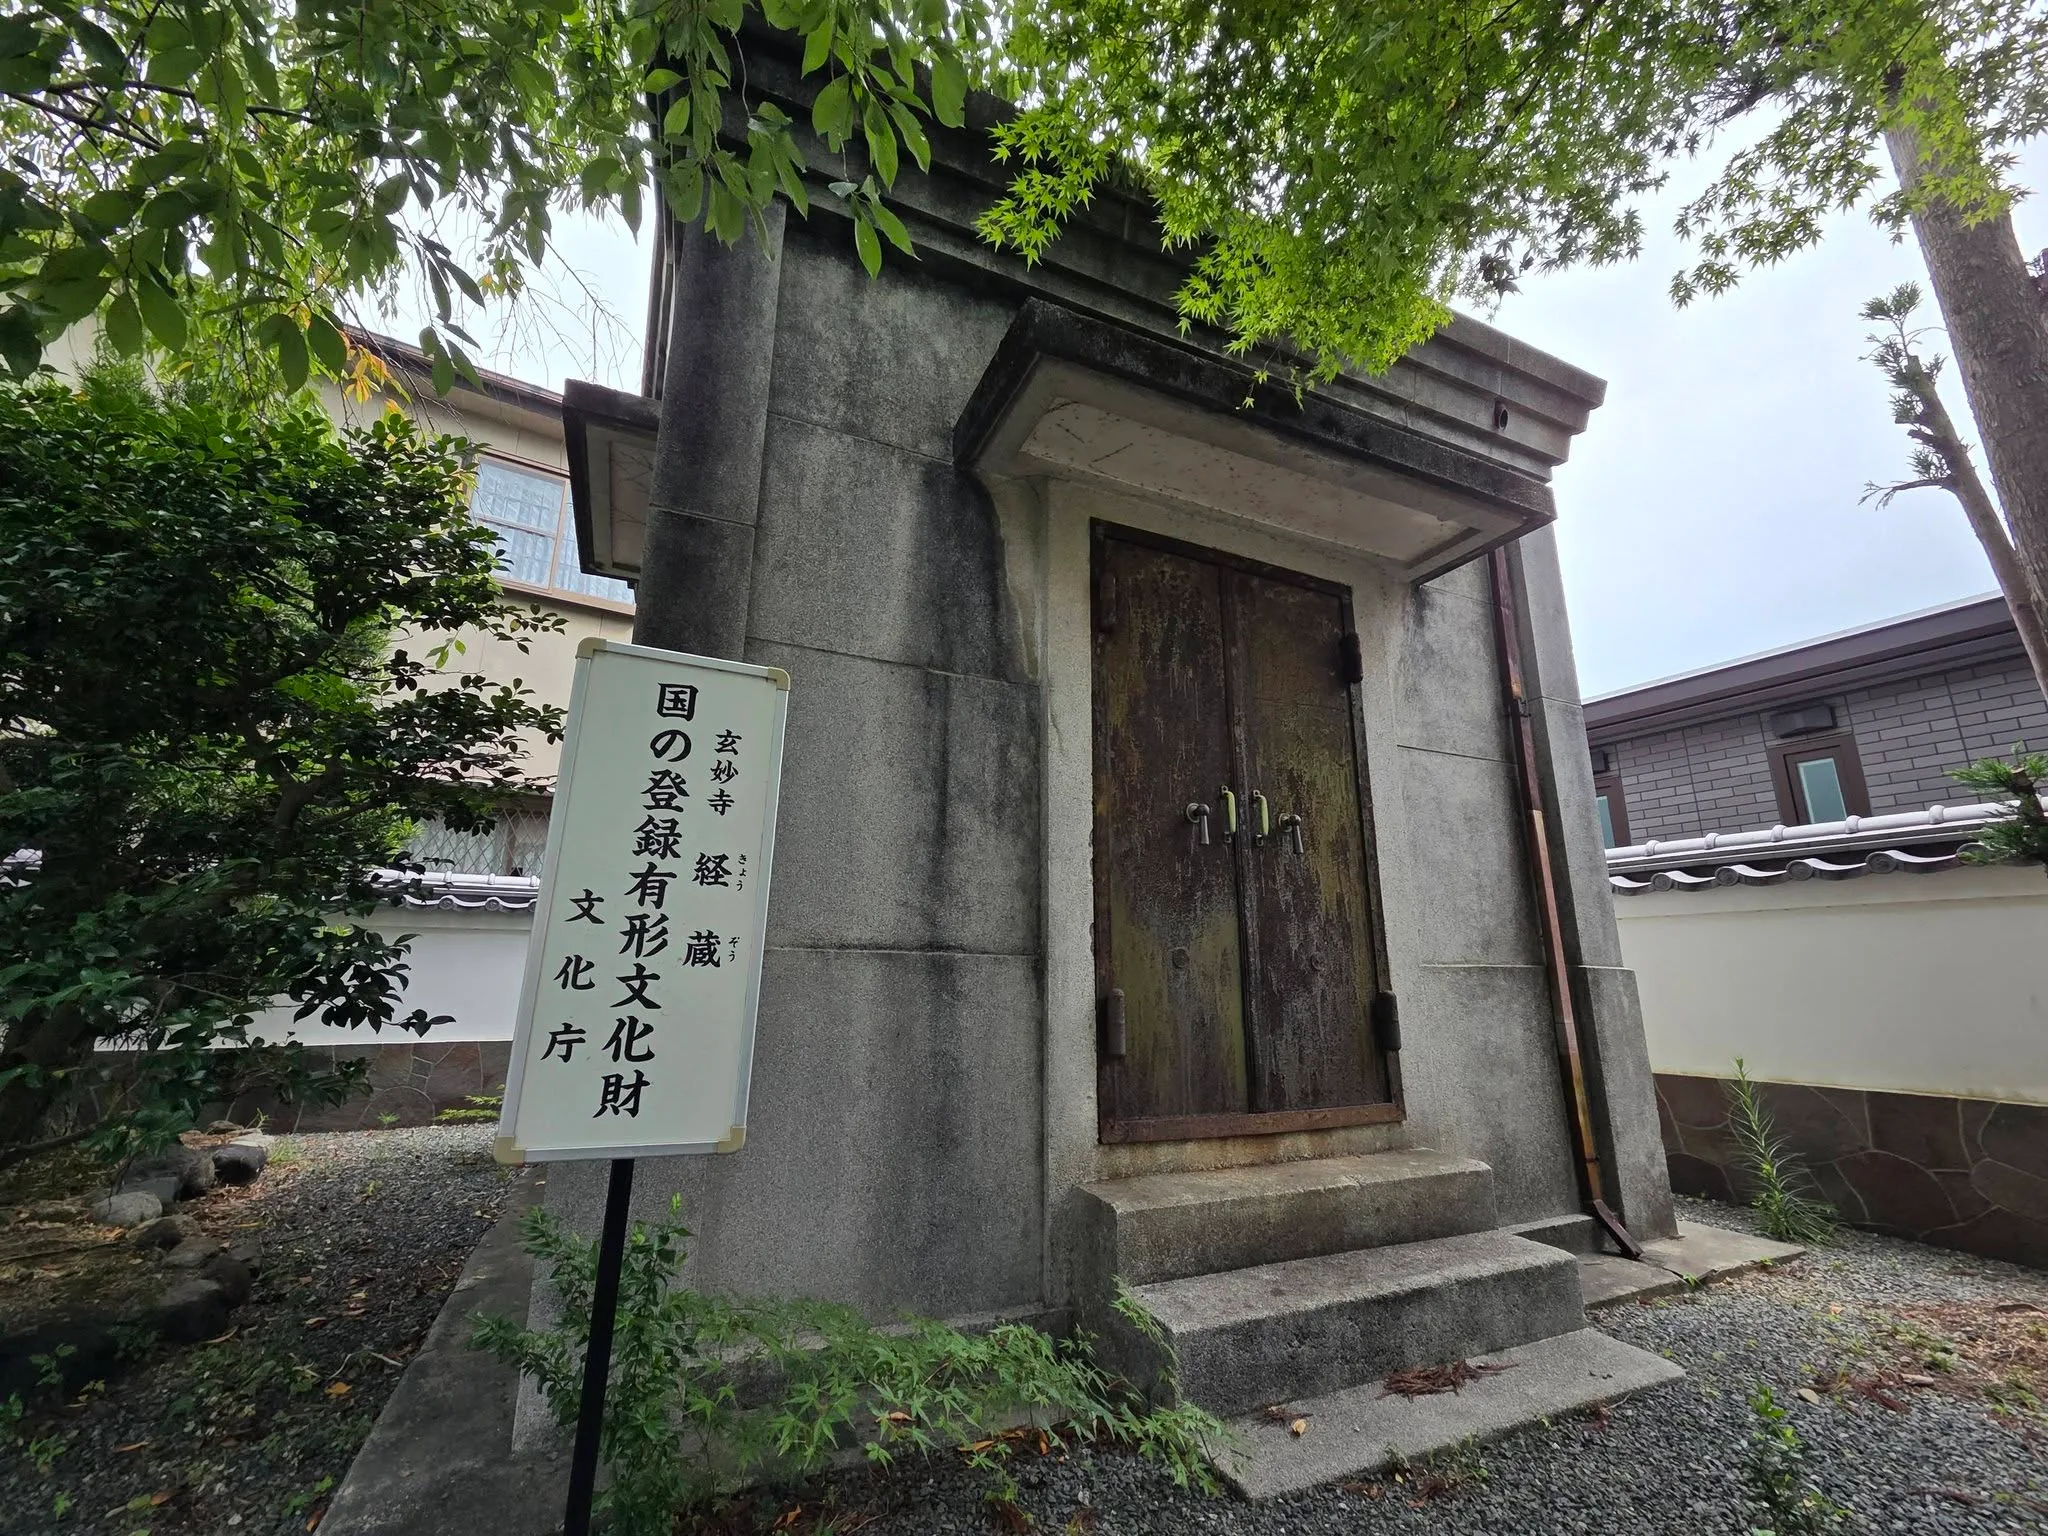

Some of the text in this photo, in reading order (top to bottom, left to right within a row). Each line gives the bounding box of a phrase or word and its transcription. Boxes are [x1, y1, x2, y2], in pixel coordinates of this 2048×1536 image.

[593, 683, 699, 1119] 国の登録有形文化財
[682, 729, 742, 967] 玄妙寺 経蔵
[728, 853, 747, 962] きょう ぞう
[540, 888, 606, 1063] 文化庁
